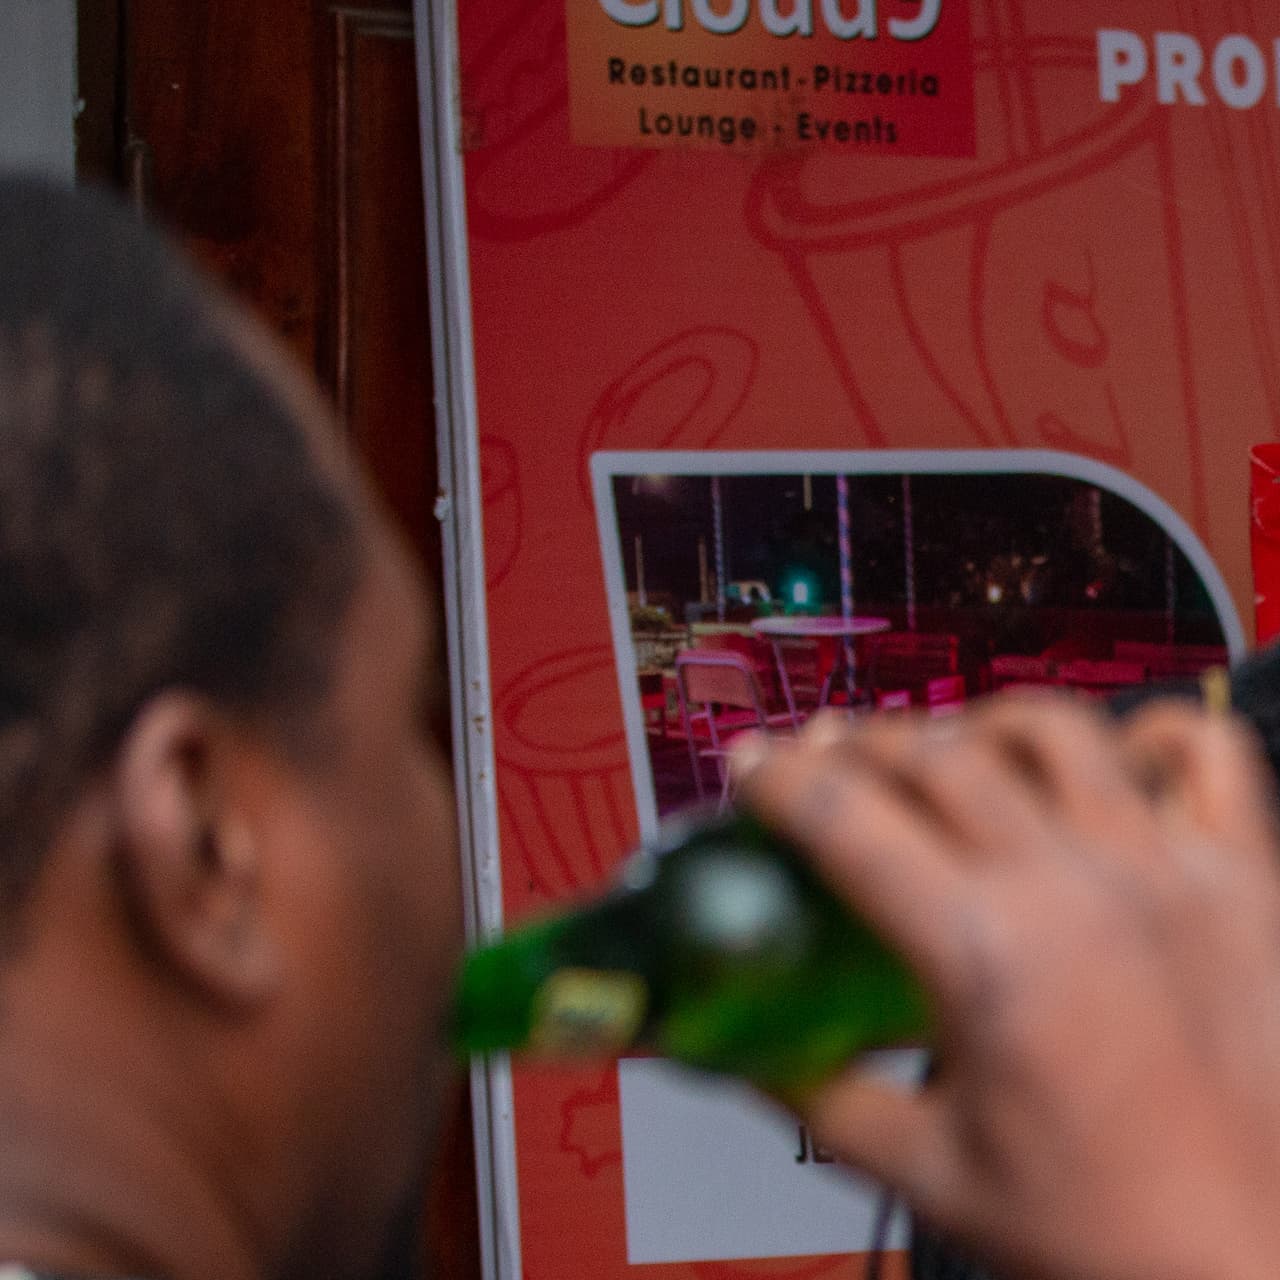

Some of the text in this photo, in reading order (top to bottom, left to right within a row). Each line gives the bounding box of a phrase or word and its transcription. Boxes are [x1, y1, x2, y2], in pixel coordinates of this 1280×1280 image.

[608, 57, 790, 91] Restaurant
[813, 65, 939, 97] Pizzeria
[639, 107, 756, 143] Lounge
[797, 112, 898, 144] Events
